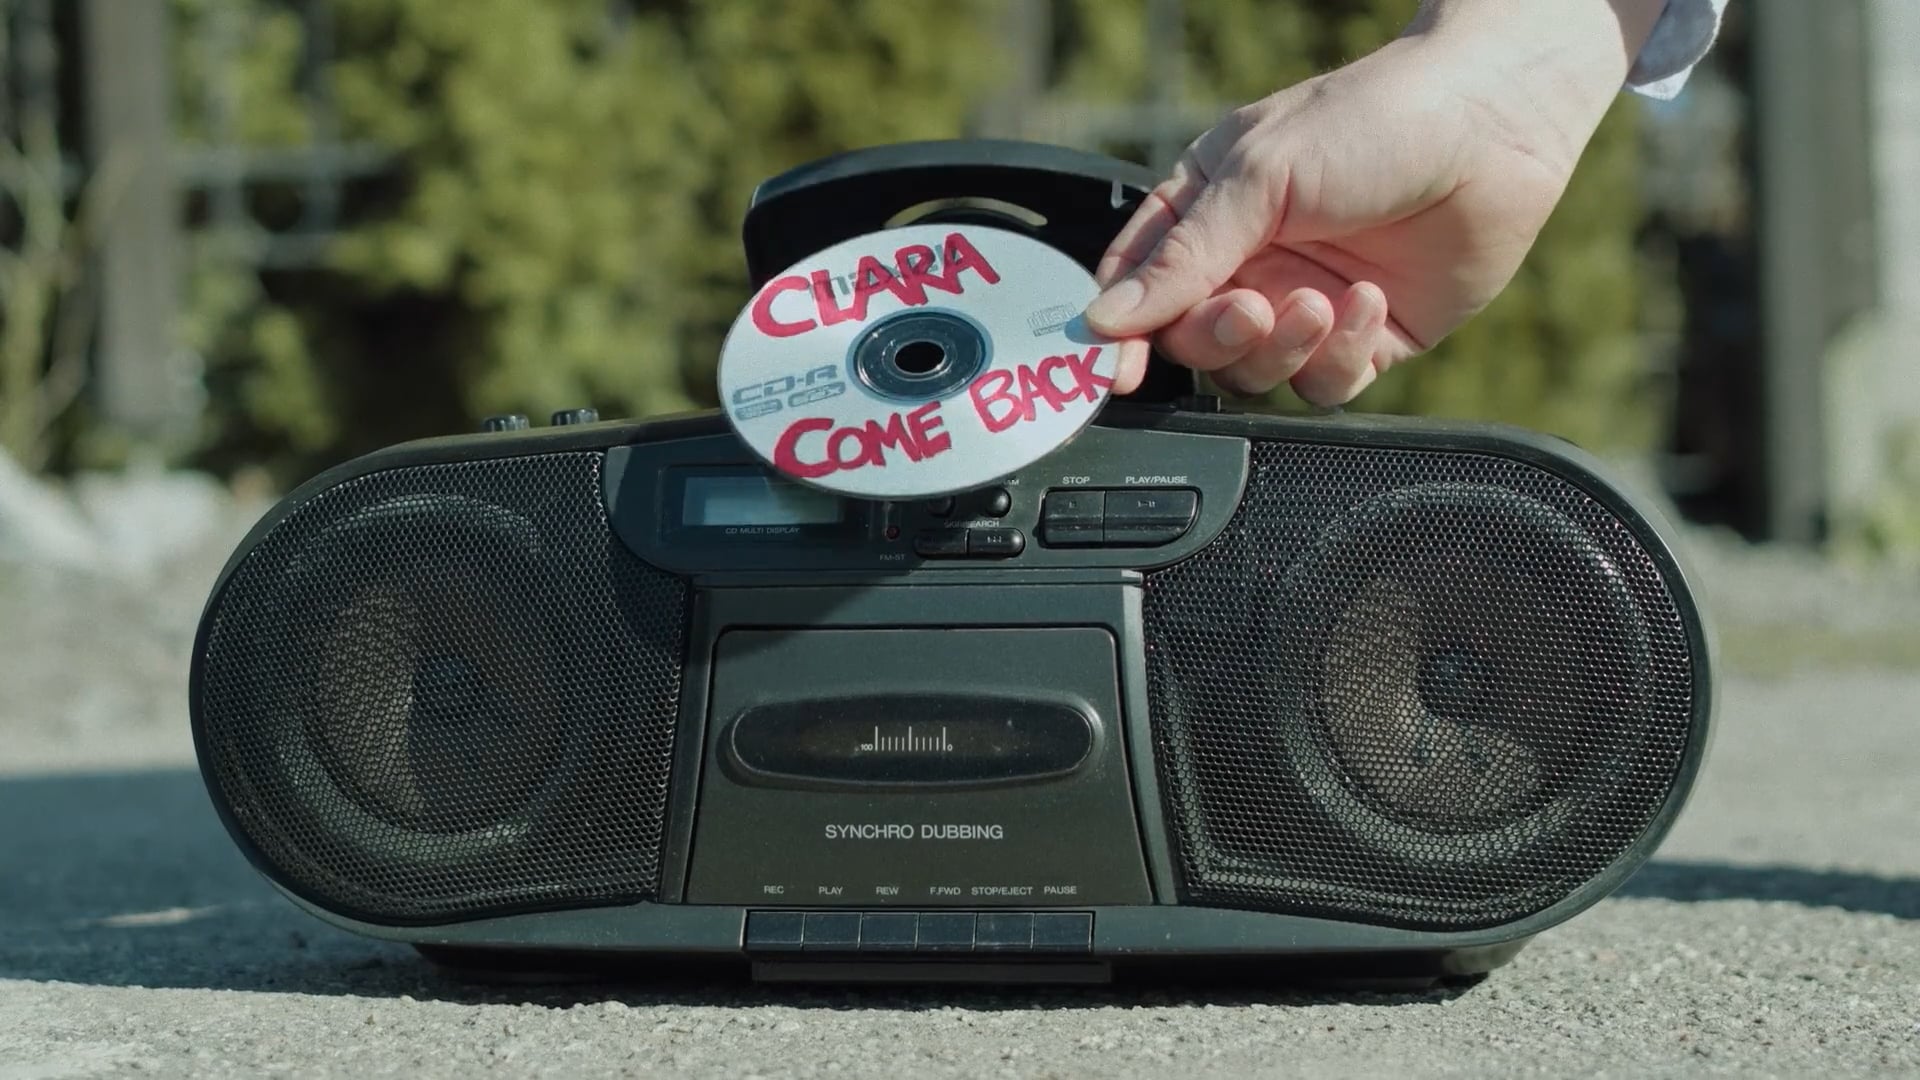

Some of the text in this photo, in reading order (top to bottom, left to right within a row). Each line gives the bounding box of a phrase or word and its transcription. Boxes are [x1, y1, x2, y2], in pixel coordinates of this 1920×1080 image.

[751, 232, 1000, 338] CLARA
[732, 364, 838, 405] CD-R
[774, 346, 1114, 478] COME BACK
[1062, 475, 1091, 485] STOP
[1125, 475, 1188, 485] PLAY/PAUSE
[725, 527, 801, 535] CD MULTI DISPLAY
[861, 743, 953, 752] 100 0
[825, 824, 1004, 840] SYNCHRO DUBBING
[763, 885, 785, 895] REC
[818, 886, 844, 896] PLAY
[876, 886, 900, 896] REW
[930, 886, 962, 896] F.FWD
[971, 886, 1034, 897] STOP/EJECT
[1043, 885, 1078, 895] PAUSE
